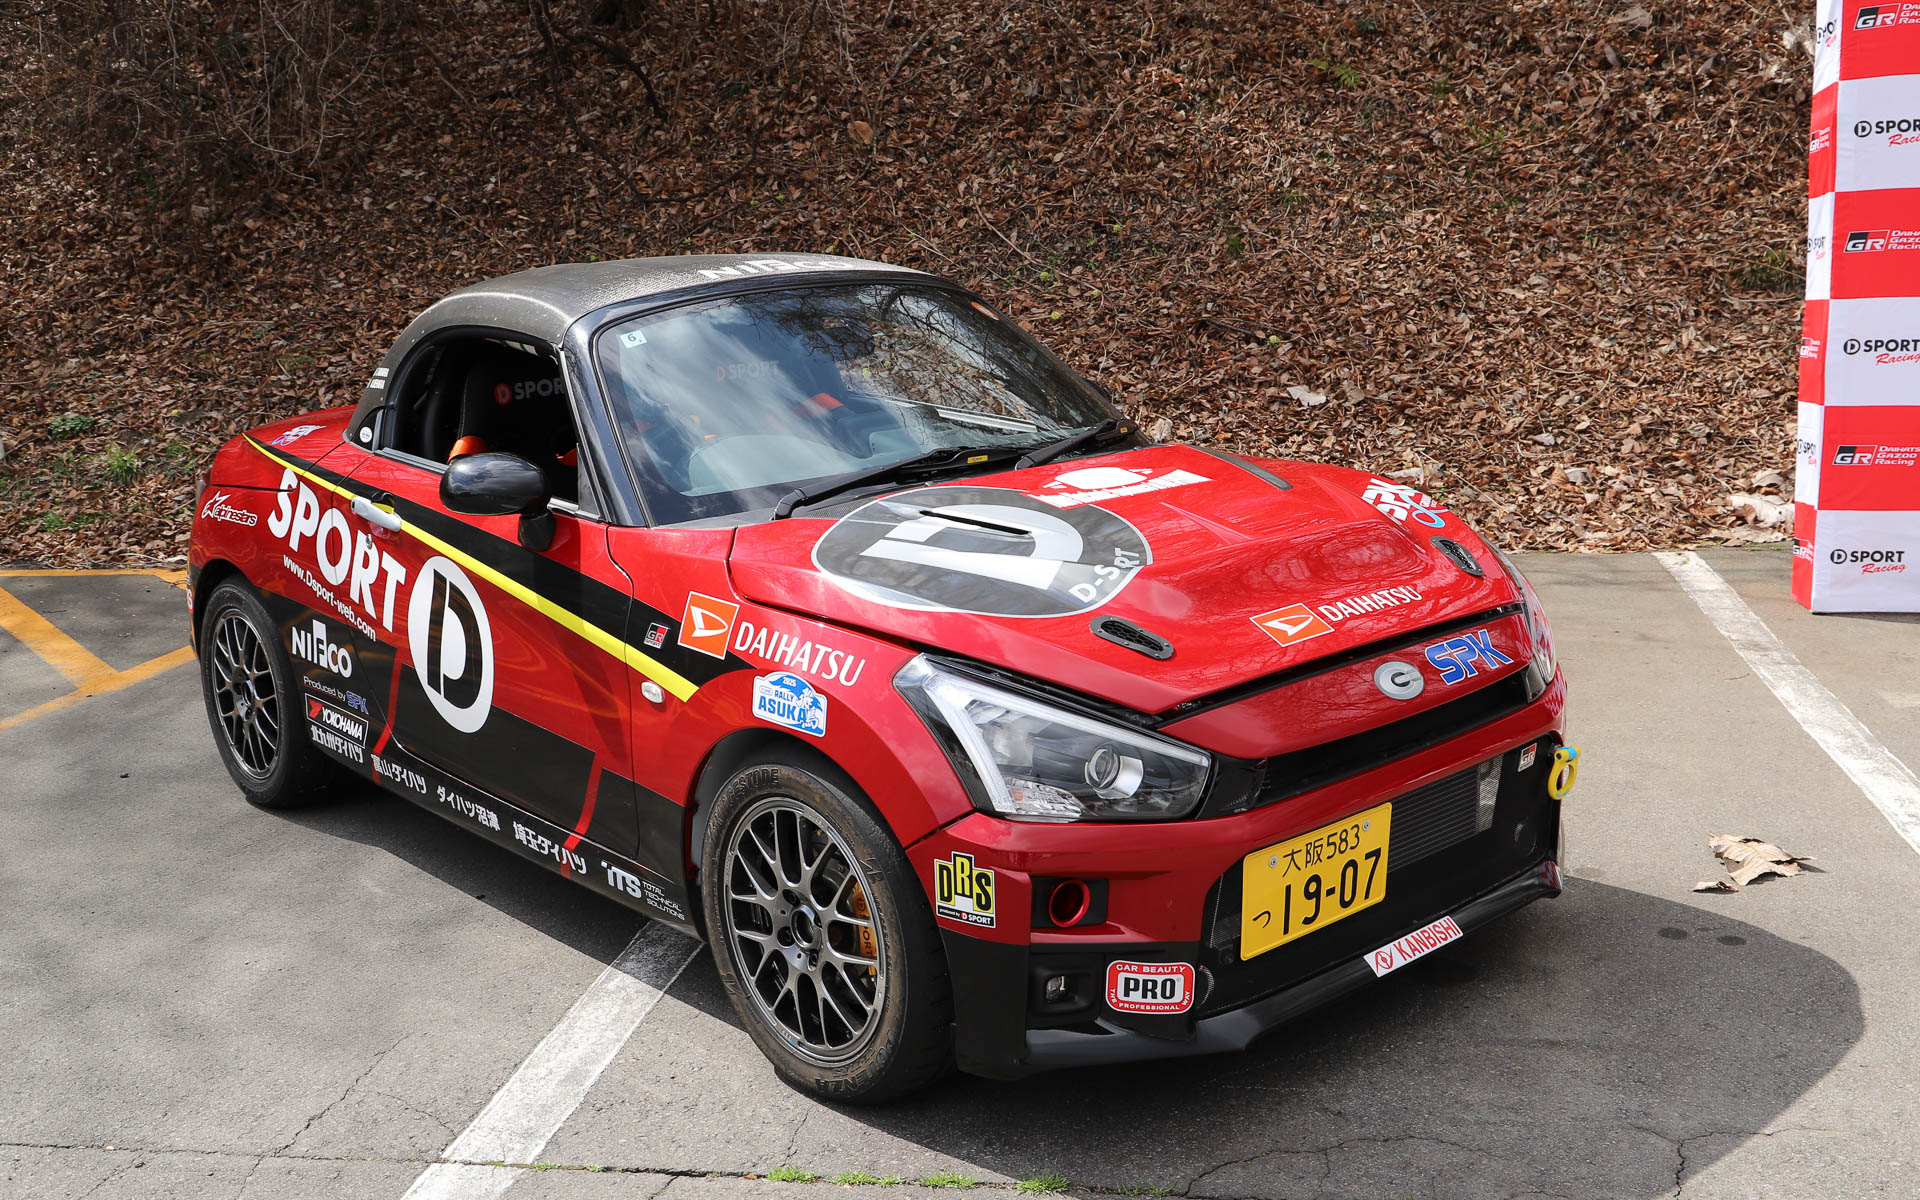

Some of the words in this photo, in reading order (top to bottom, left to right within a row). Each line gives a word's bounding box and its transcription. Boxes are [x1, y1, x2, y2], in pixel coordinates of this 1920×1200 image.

[1857, 13, 1896, 28] GR
[1846, 239, 1885, 250] GR
[698, 259, 853, 279] NIFCO
[1863, 338, 1920, 352] SPORT
[1835, 452, 1873, 464] GR
[1875, 459, 1914, 467] Racing
[267, 467, 407, 633] SPORT
[1850, 550, 1905, 563] SPORT
[1861, 562, 1907, 575] Racing
[283, 554, 377, 642] www.Dsport-web.com
[1317, 585, 1423, 622] DAIHATSU
[292, 618, 352, 679] NIFCO
[734, 621, 866, 687] DAIHATSU
[1424, 628, 1515, 686] SPK
[303, 675, 337, 697] Produced
[337, 689, 347, 702] by
[774, 689, 795, 703] RALLY
[758, 695, 807, 723] ASUKA
[322, 706, 363, 741] YOKOHAMA
[371, 753, 427, 795] 富山ダイハツ
[513, 820, 587, 875] 埼玉ダイハツ
[642, 881, 665, 897] TOTAL
[938, 855, 992, 912] DRS
[1252, 910, 1271, 929] つ
[1282, 847, 1382, 936] 19-07
[644, 889, 682, 912] TECHNICAL
[646, 898, 685, 921] SOLUTIONS
[968, 914, 991, 924] SPORT
[1392, 915, 1461, 961] KANBISHI
[1116, 964, 1139, 972] CAR
[1142, 965, 1186, 973] BEAUTY
[1110, 988, 1118, 1003] THE
[1118, 1003, 1180, 1011] PROFESSIONAL
[1181, 991, 1190, 1006] WAY
[1123, 976, 1176, 1000] PRO
